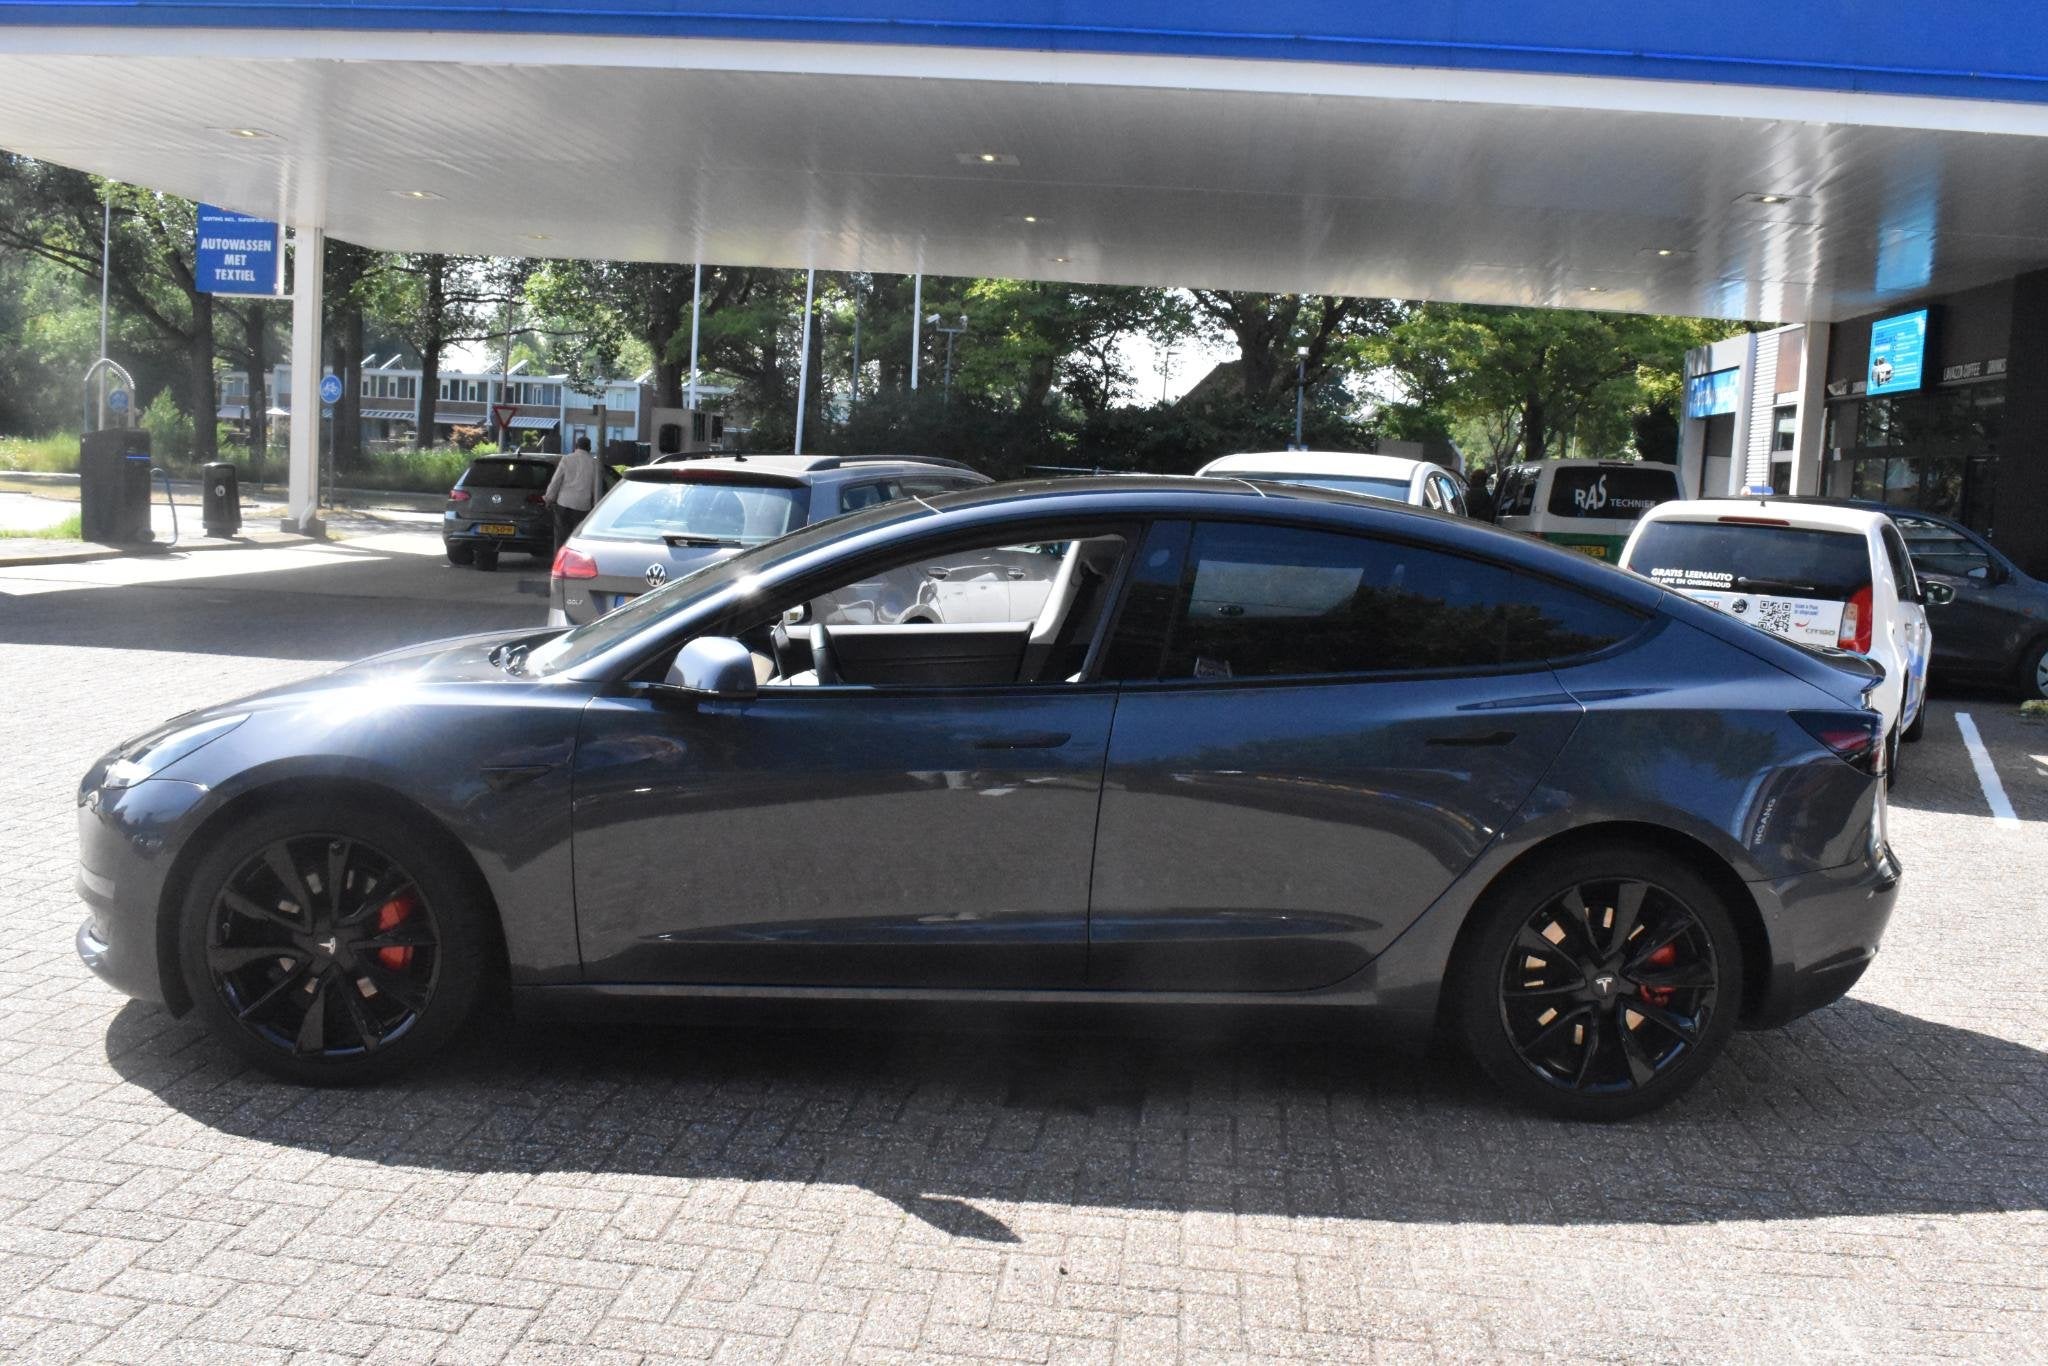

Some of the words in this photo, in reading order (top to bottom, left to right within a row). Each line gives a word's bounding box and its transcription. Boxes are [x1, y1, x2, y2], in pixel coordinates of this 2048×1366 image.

[201, 238, 272, 251] AUTOWASSEN
[224, 254, 247, 266] MET
[215, 269, 256, 281] TEXTIEL
[1575, 474, 1607, 510] RAS
[1651, 568, 1683, 577] GRATIS
[1685, 570, 1733, 581] LEENAUTO
[1687, 579, 1731, 588] ONDERHOUD
